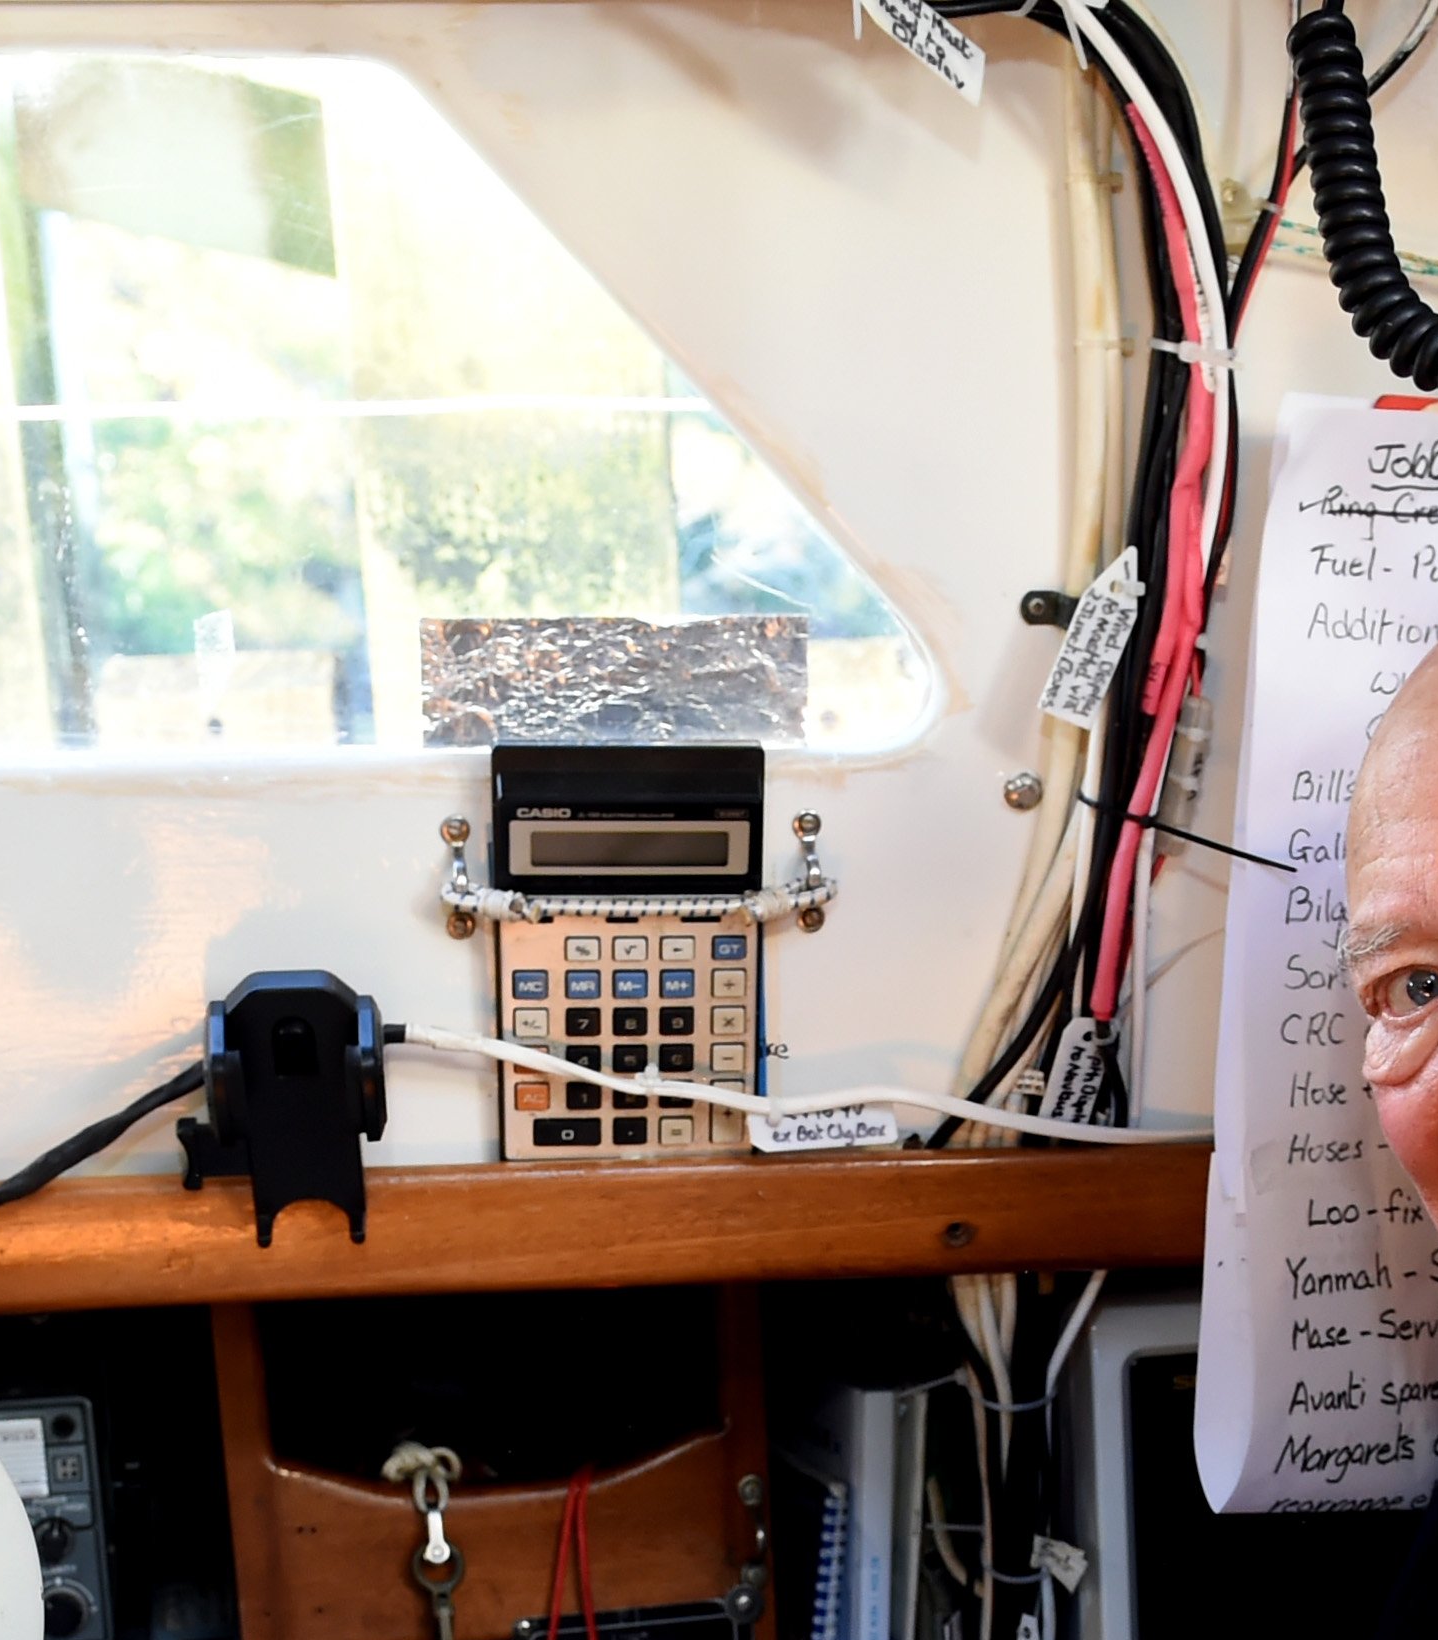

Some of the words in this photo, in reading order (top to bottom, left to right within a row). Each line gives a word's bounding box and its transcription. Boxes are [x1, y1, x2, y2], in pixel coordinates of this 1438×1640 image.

[516, 807, 571, 818] CASIO
[718, 943, 741, 955] GT
[518, 980, 544, 992] MC
[570, 980, 596, 992] MR
[665, 980, 690, 992] M+
[577, 1018, 590, 1030] 7
[1280, 1011, 1346, 1046] CRC
[577, 1055, 590, 1067] 4
[1289, 1071, 1348, 1108] Hose
[1287, 1133, 1363, 1164] Hoses
[1288, 1370, 1366, 1415] Avanti
